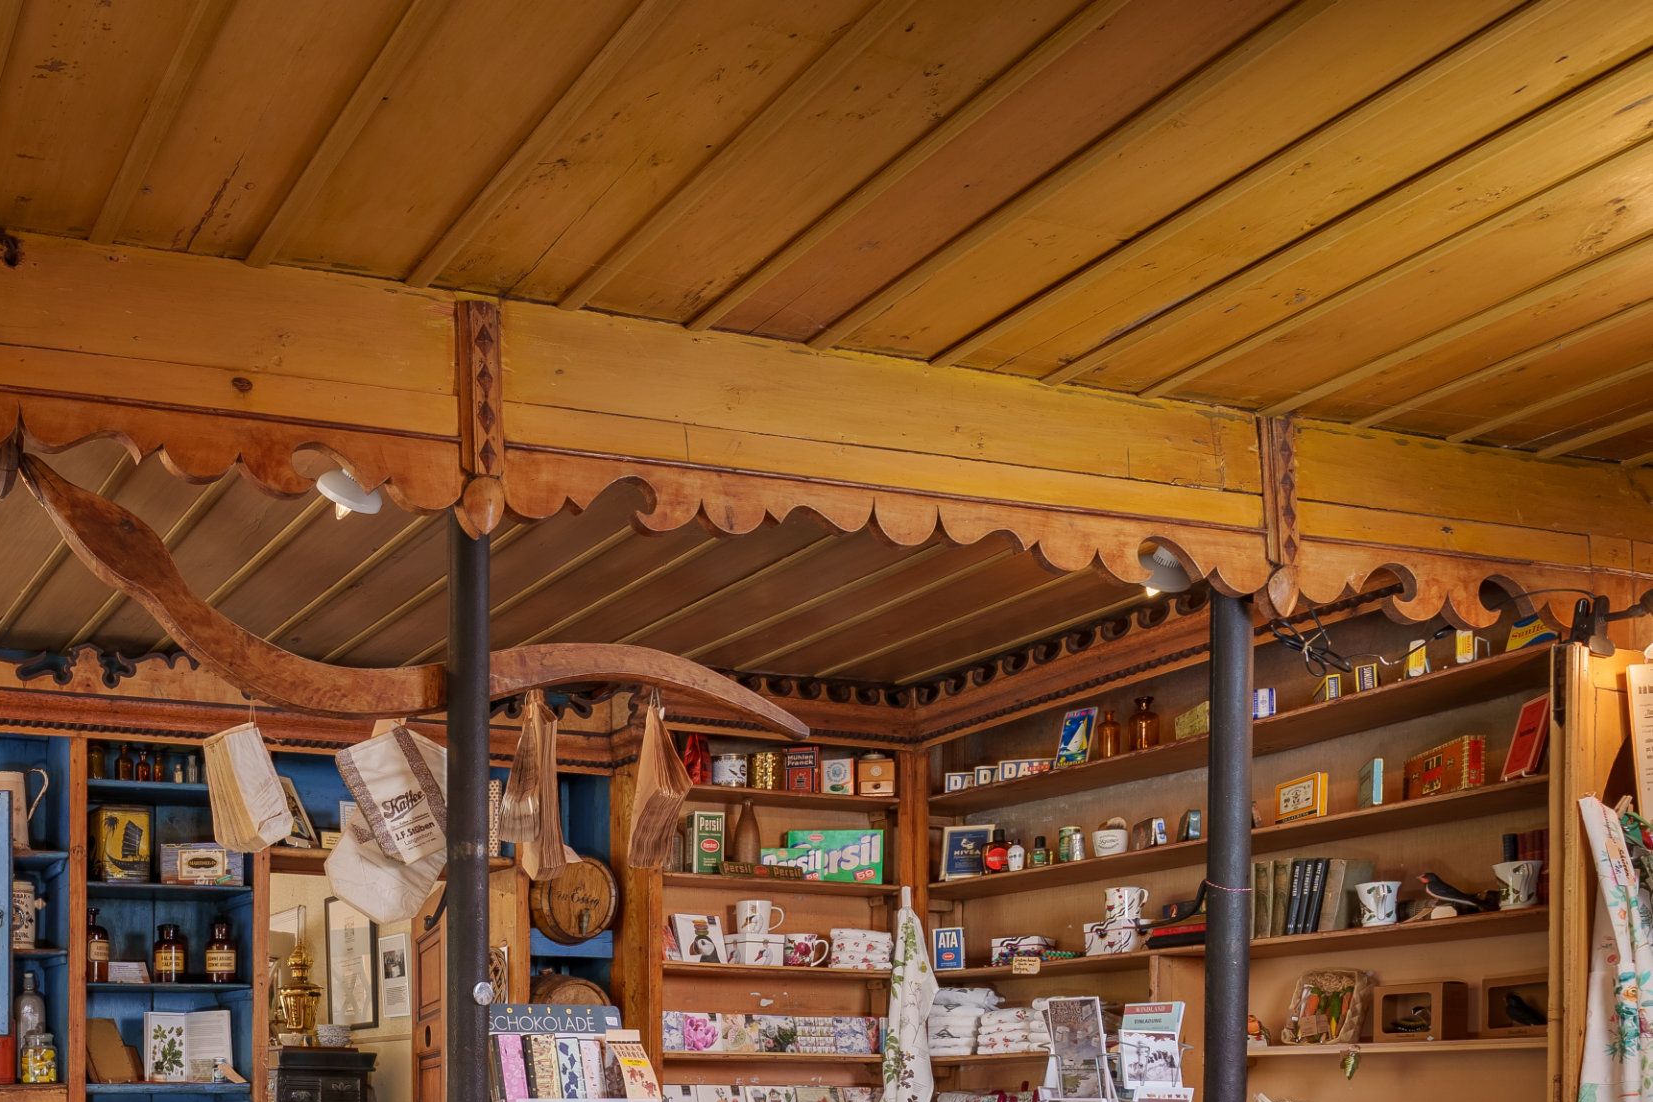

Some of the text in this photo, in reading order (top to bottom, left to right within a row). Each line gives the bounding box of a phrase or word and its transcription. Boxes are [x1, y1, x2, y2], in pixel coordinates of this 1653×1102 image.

[381, 789, 426, 819] Kaffee
[699, 816, 723, 832] Persil
[938, 931, 959, 949] ATA
